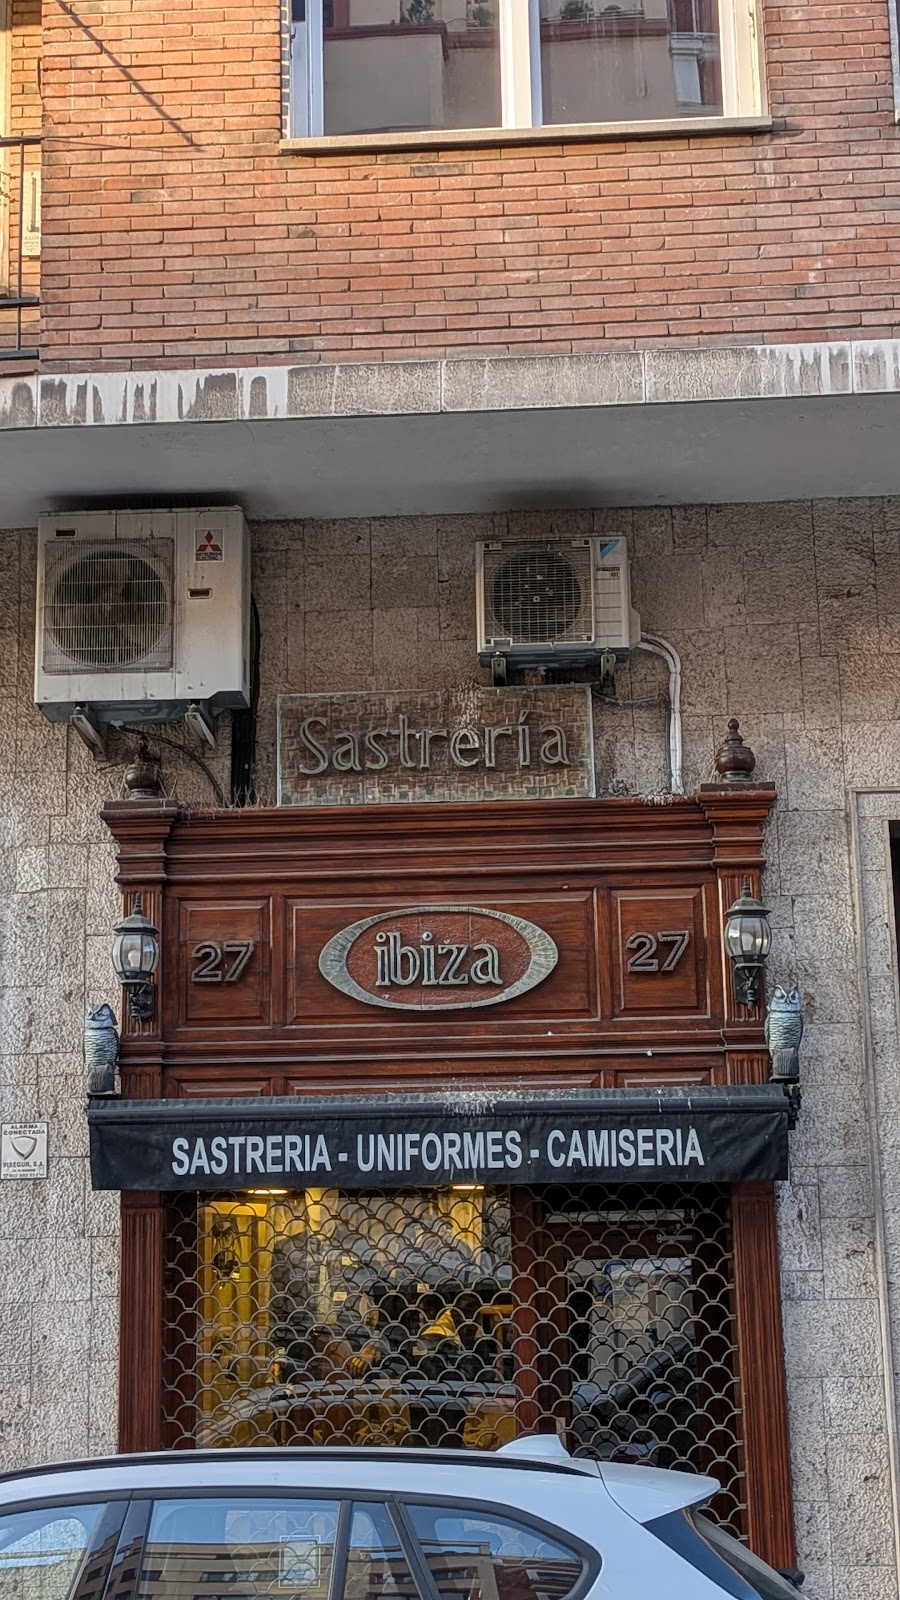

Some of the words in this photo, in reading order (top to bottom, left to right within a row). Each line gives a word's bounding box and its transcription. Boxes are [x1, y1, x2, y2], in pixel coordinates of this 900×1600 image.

[299, 710, 571, 775] Sastrería
[191, 940, 255, 982] 27
[374, 931, 503, 986] ibiza
[626, 930, 690, 972] 27
[172, 1134, 332, 1176] SASTRERIA
[357, 1130, 522, 1172] UNIFORMES
[547, 1128, 705, 1168] CAMISERIA
